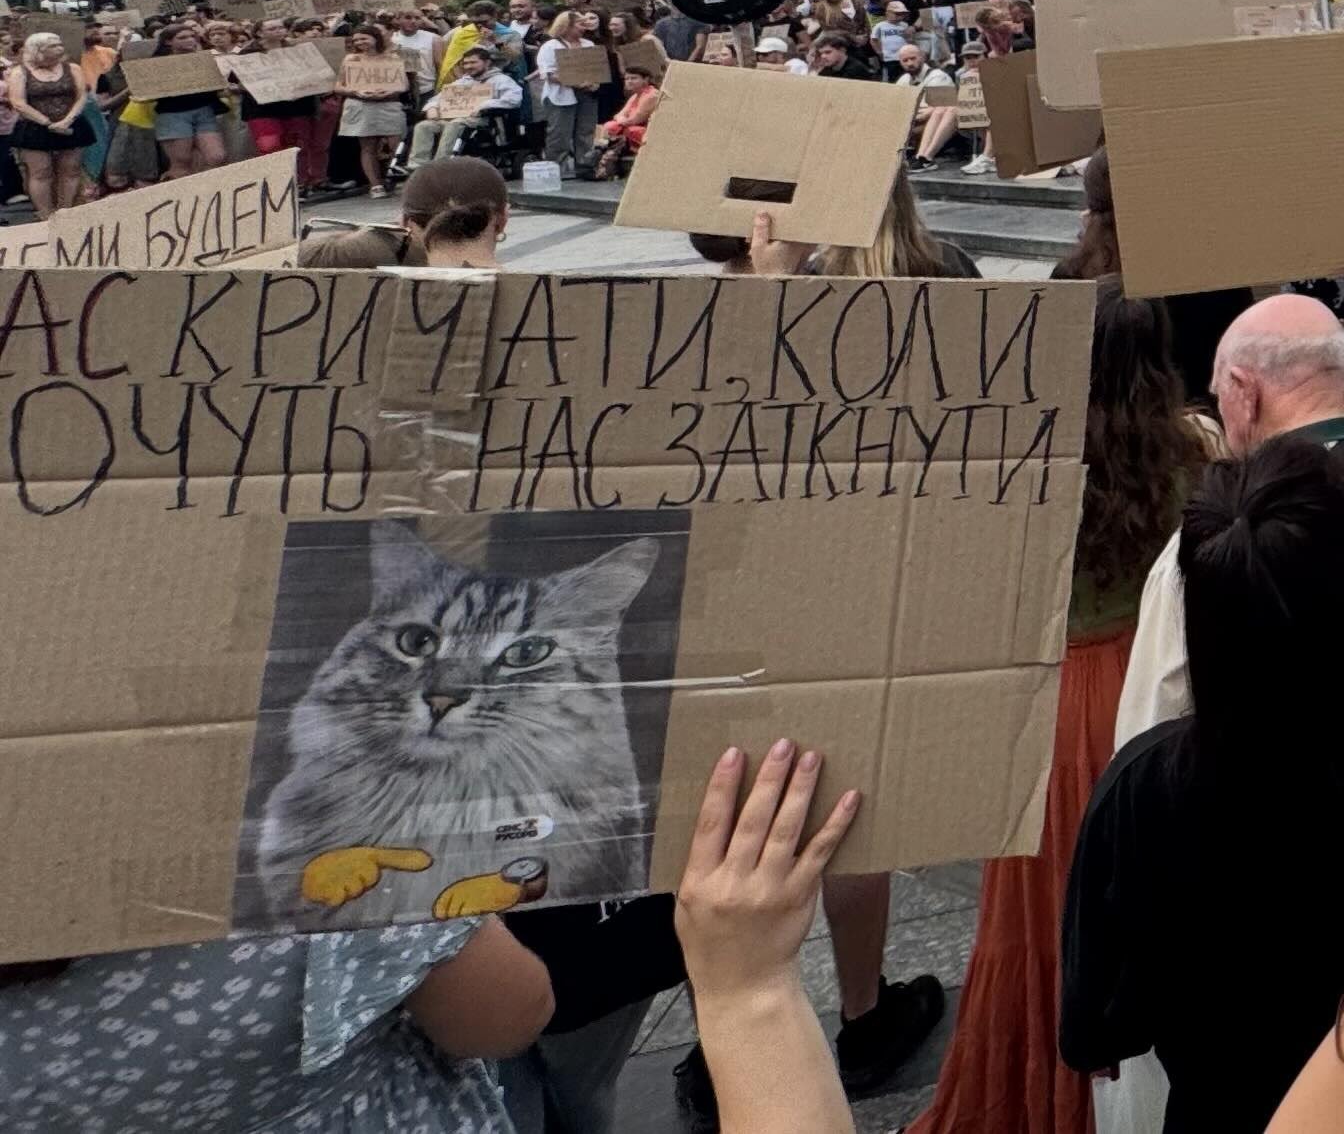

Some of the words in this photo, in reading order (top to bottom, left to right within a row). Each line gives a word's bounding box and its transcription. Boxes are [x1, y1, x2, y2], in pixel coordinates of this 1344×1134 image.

[145, 177, 298, 266] БУДЕМ
[0, 270, 138, 381] АС
[766, 279, 1048, 404] КОЛИ
[9, 380, 372, 518] ОЧУТЬ
[463, 396, 634, 513] НАС
[656, 400, 1061, 511] ЗАТКНУТИ
